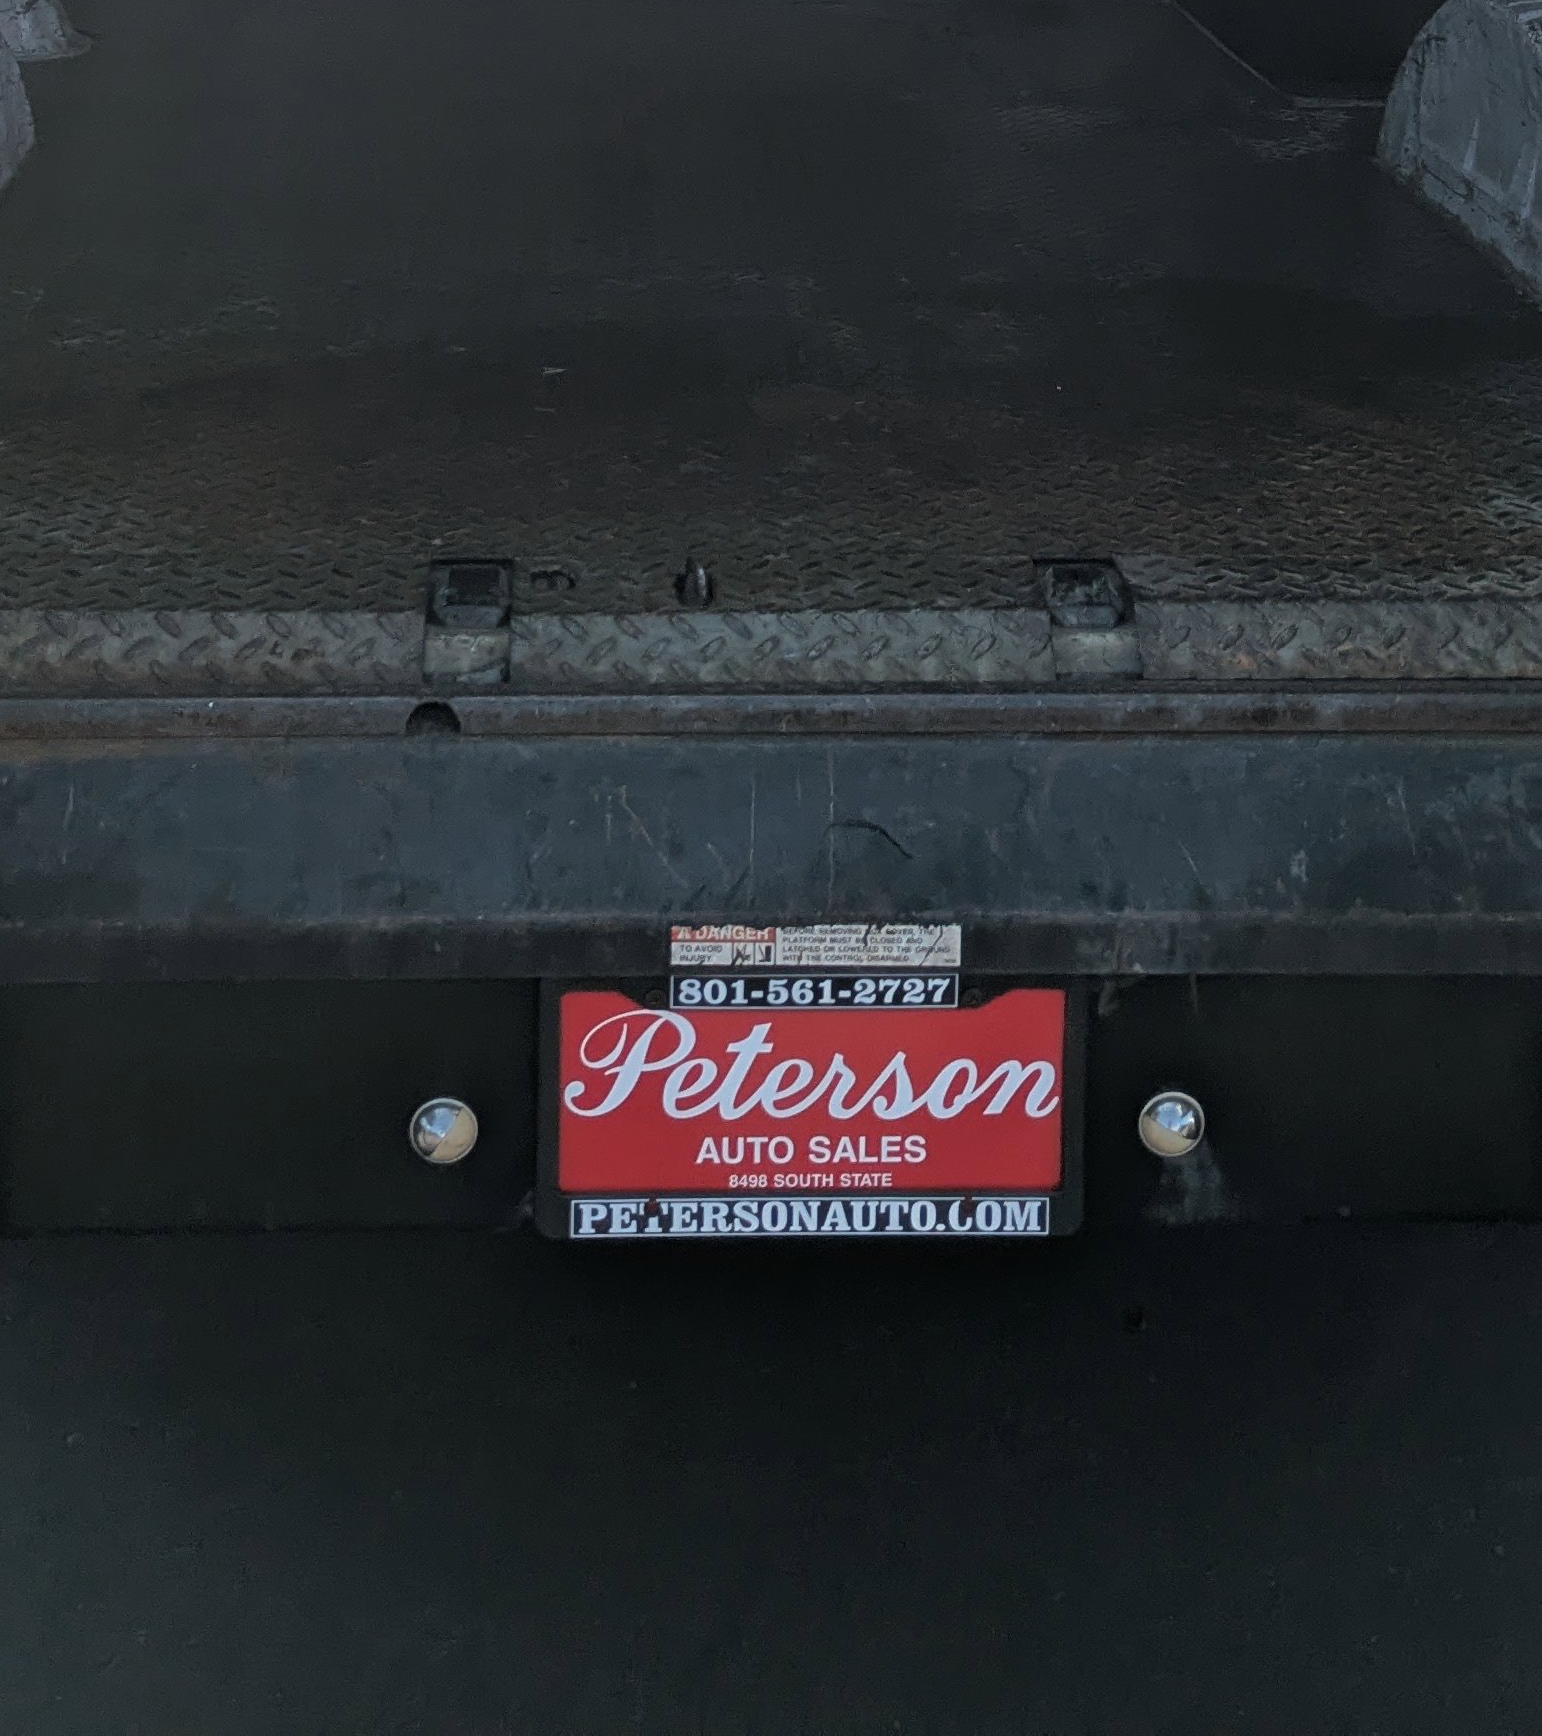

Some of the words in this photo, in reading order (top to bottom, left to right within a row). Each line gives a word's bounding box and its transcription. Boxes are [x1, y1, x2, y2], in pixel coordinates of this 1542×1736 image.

[677, 977, 951, 1005] 801-561-2727
[564, 1008, 1060, 1121] Peterson
[695, 1136, 796, 1164] AUTO
[808, 1135, 928, 1164] SALES
[728, 1174, 768, 1189] 8498
[773, 1173, 835, 1188] SOUTH
[840, 1172, 893, 1187] STATE
